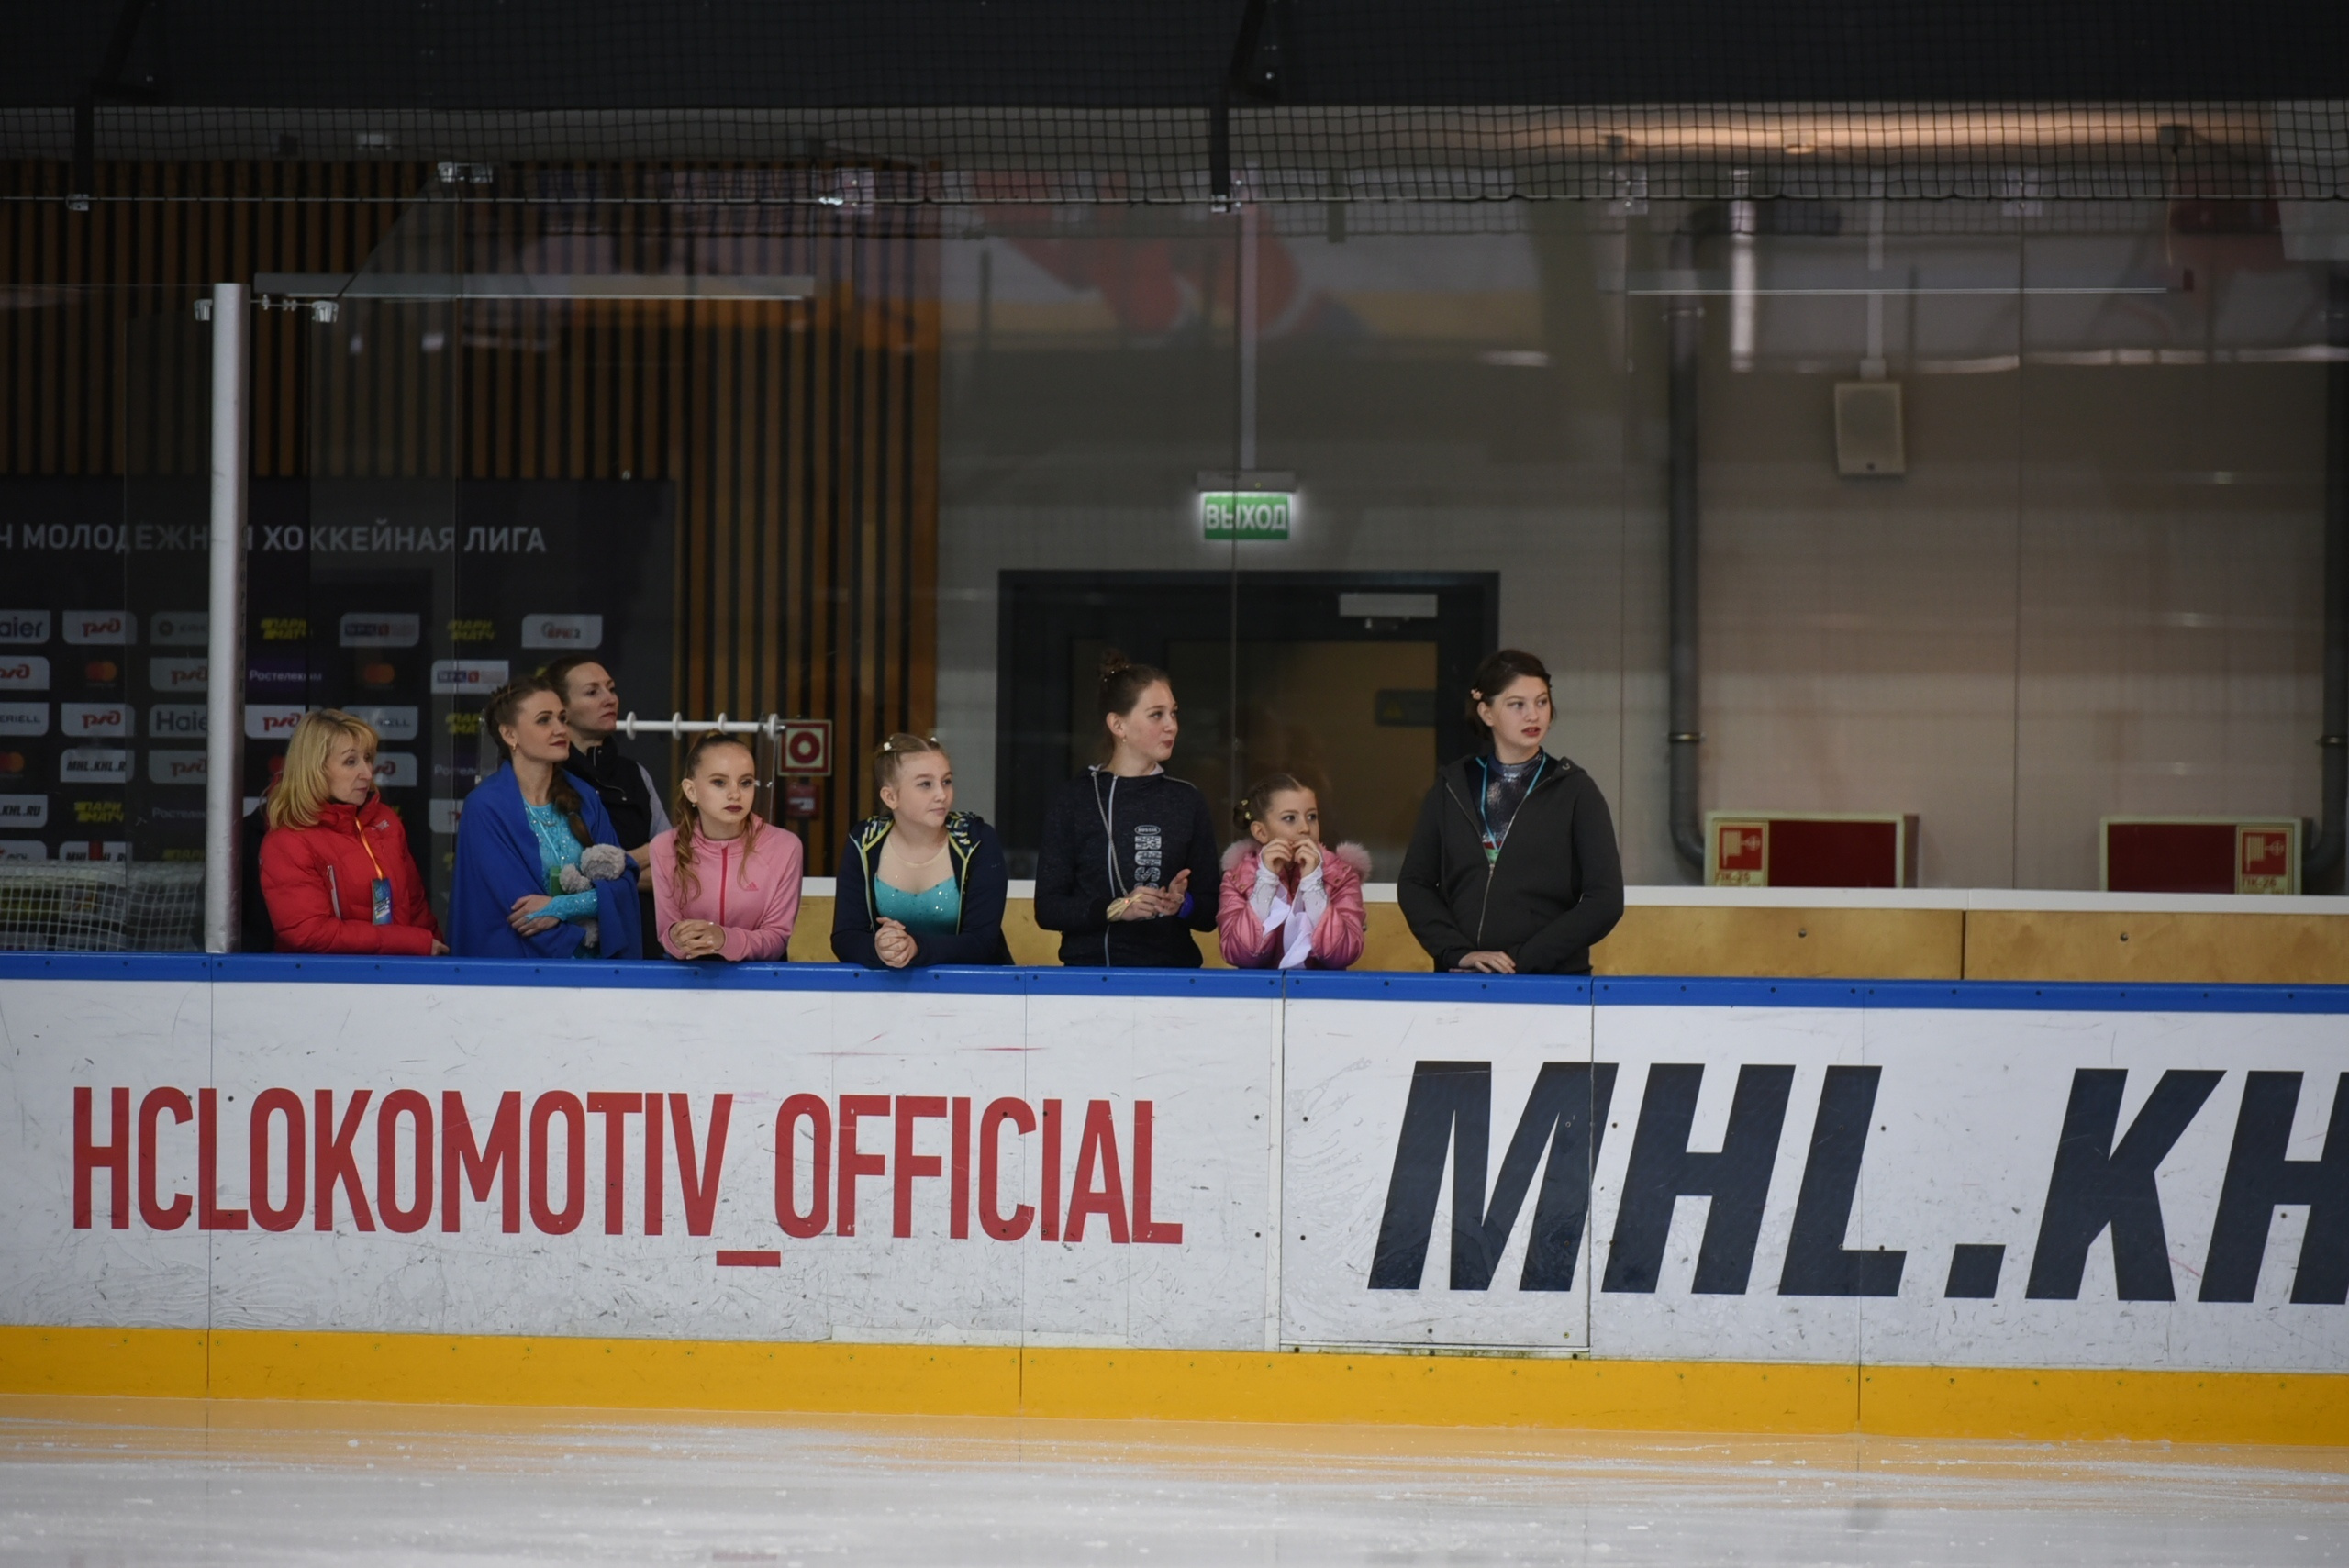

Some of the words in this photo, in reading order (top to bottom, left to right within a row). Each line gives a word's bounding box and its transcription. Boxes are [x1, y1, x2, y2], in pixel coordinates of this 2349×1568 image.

[1206, 503, 1287, 530] ВЫХОД
[23, 523, 252, 554] МОЛОДЕЖН
[263, 518, 455, 551] ХОККЕЙНАЯ
[463, 527, 546, 552] ЛИГА
[250, 670, 322, 683] Ростелекм
[156, 709, 208, 731] Haie
[72, 1086, 1184, 1267] HCLOKOMOTIV_OFFICIAL
